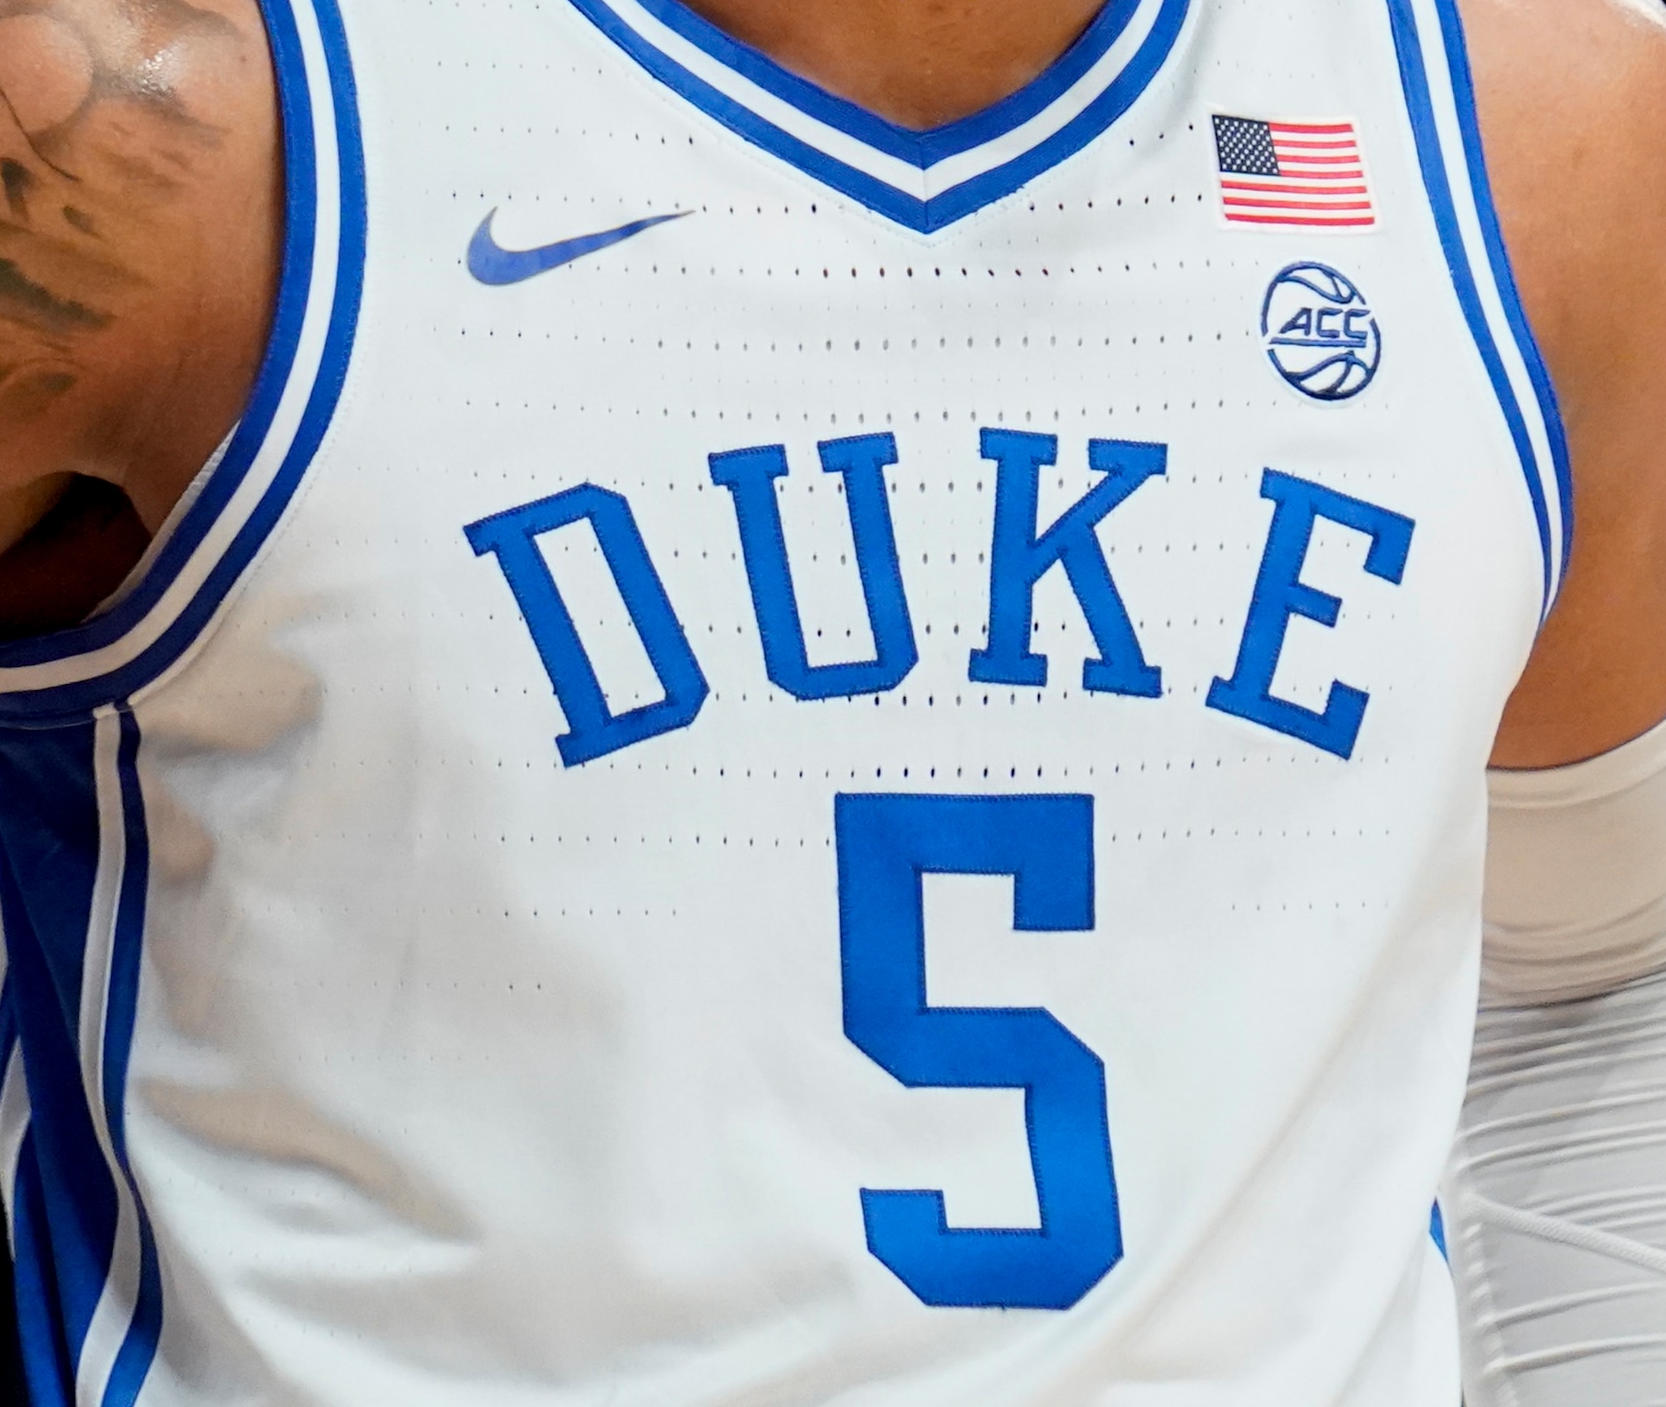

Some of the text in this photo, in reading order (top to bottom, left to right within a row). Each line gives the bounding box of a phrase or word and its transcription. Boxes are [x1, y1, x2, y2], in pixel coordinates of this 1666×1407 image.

[1279, 307, 1371, 340] ACC
[464, 428, 1415, 767] DUKE
[835, 792, 1123, 1310] 5
